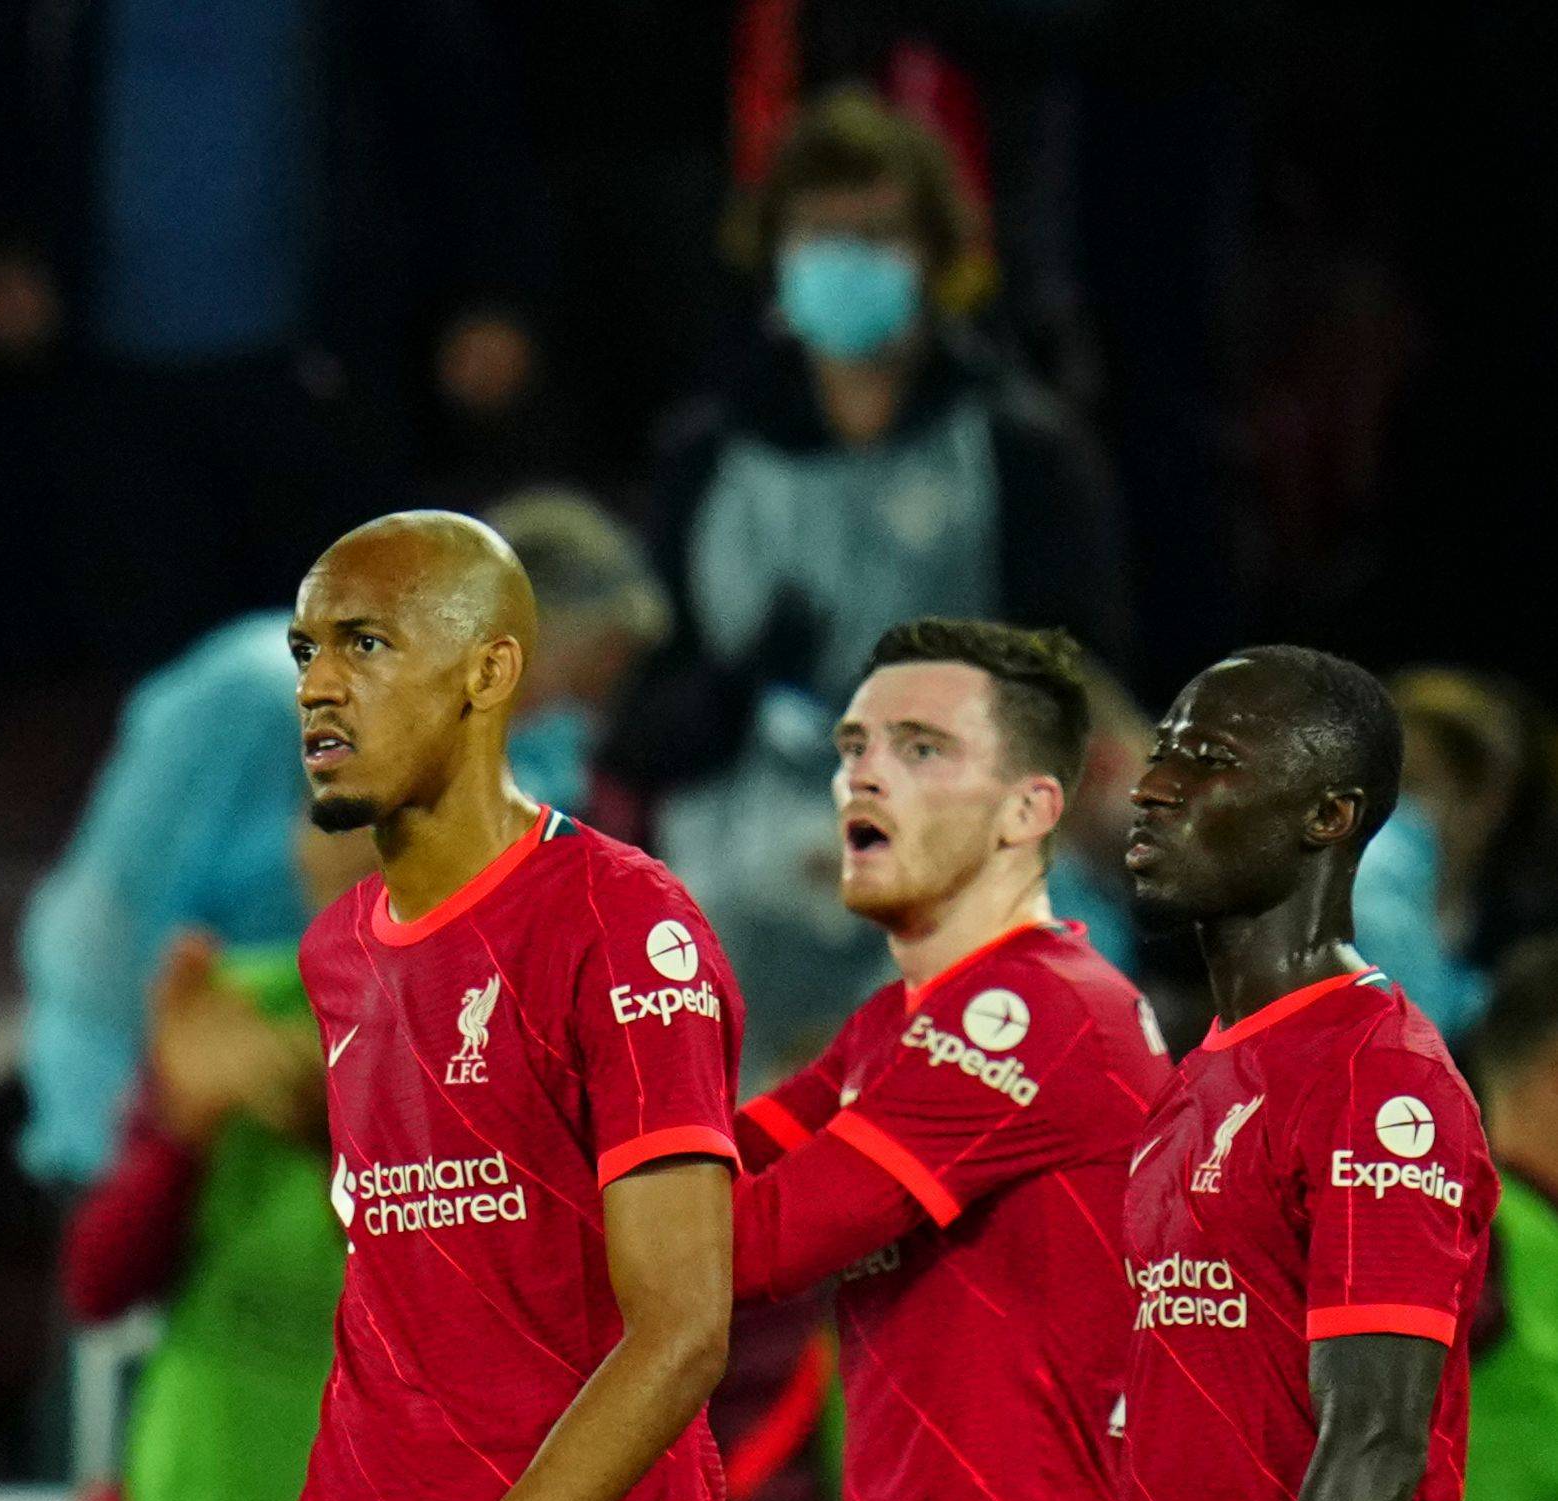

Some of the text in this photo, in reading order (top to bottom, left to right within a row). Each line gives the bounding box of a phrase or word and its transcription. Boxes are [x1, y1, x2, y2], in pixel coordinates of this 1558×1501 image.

[901, 1014, 1039, 1107] Expedia
[359, 1150, 509, 1199] standard
[1331, 1149, 1463, 1208] Expedia
[364, 1184, 527, 1236] chartered
